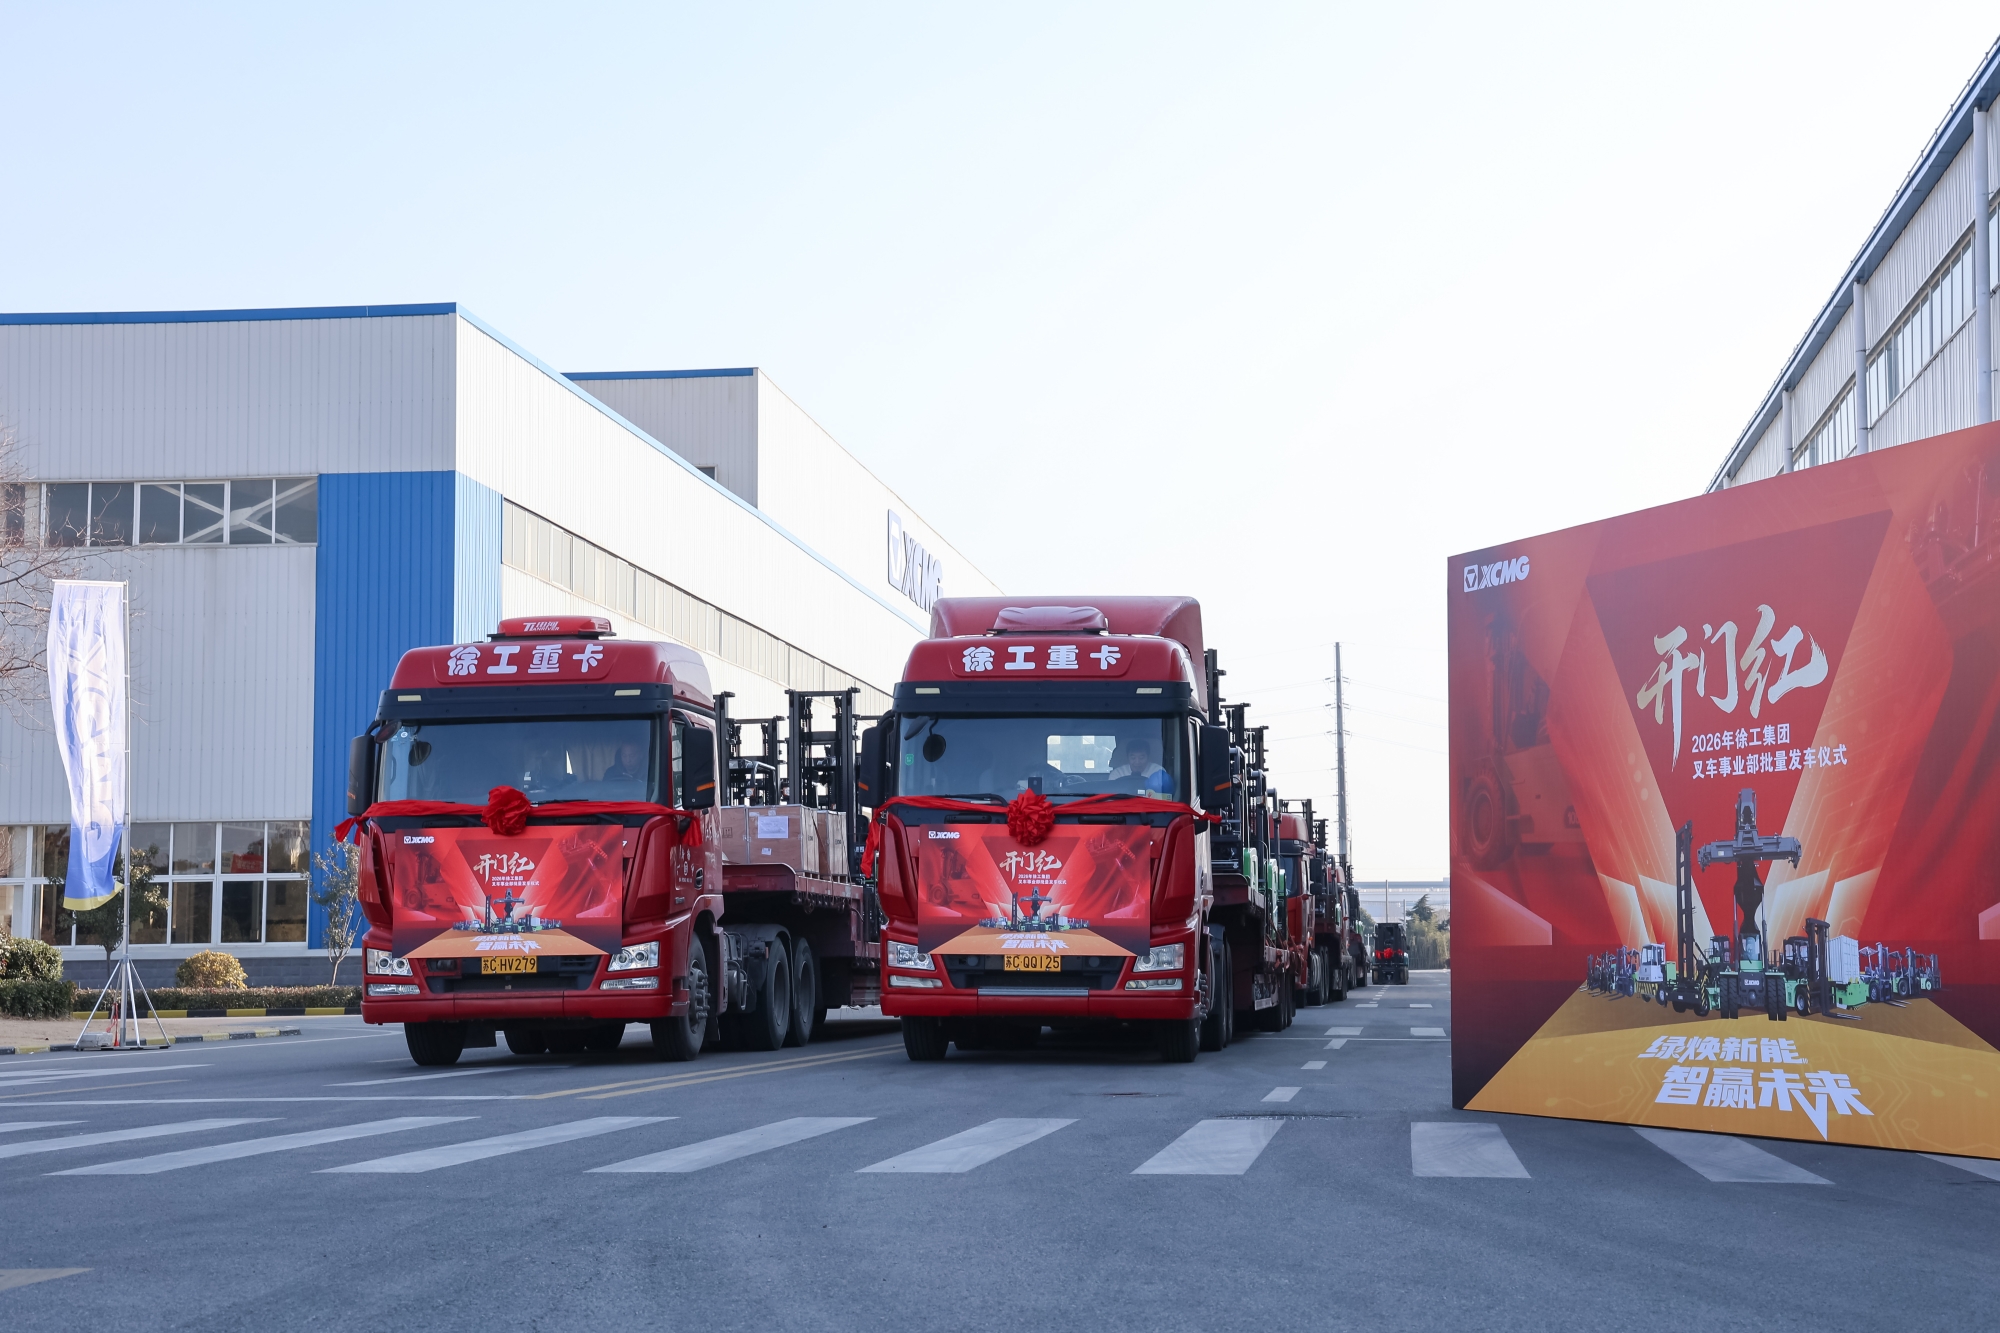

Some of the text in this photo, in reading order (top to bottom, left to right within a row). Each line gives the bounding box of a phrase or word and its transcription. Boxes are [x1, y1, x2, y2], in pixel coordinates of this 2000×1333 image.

[1477, 555, 1530, 590] XCMG
[447, 643, 604, 676] 徐工重卡
[962, 645, 1121, 672] 徐工重卡
[1637, 604, 1828, 772] 开门红
[1691, 723, 1790, 753] 2026年徐工集团
[1692, 744, 1848, 780] 叉车事业部批量发车仪式
[411, 836, 435, 844] XCMG
[936, 831, 960, 839] XCMG
[473, 852, 535, 884] 开门红
[999, 850, 1062, 882] 开门红
[1637, 1035, 1804, 1064] 绿焕新能
[1654, 1065, 1875, 1141] 智赢未来
